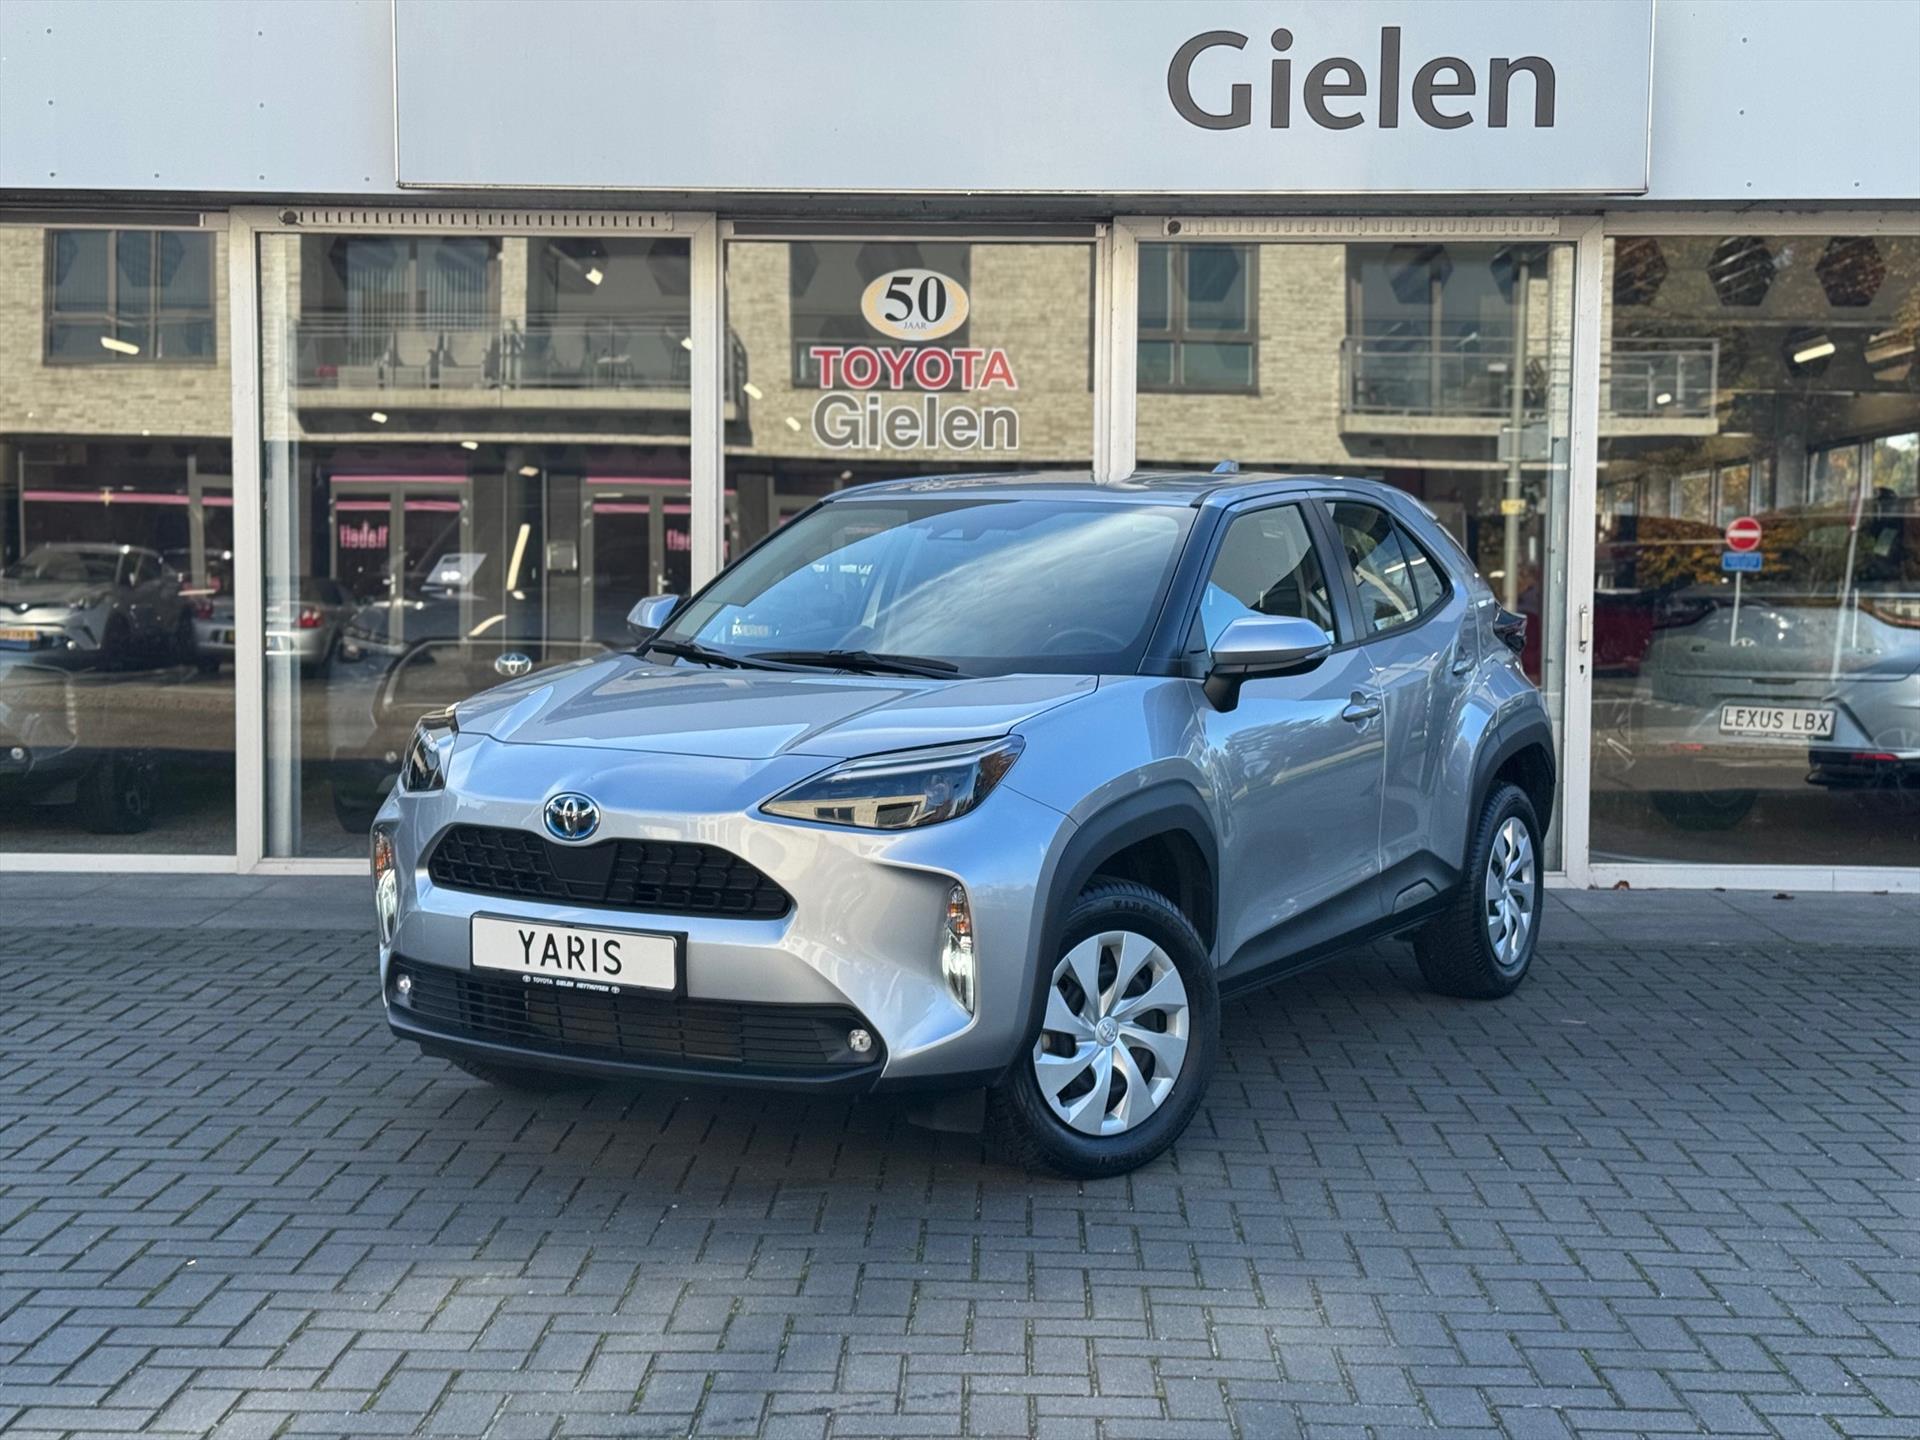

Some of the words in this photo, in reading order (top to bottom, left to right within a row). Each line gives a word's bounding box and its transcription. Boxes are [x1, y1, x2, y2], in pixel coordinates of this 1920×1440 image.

[1167, 26, 1556, 130] Gielen
[884, 275, 947, 323] 50
[903, 321, 928, 330] JAAR
[811, 347, 1017, 390] TOYOTA
[813, 392, 1018, 449] Gielen
[1723, 708, 1784, 729] LEXUS
[1792, 712, 1830, 732] LBX
[518, 929, 622, 975] YARIS
[533, 976, 553, 985] TOYOTA
